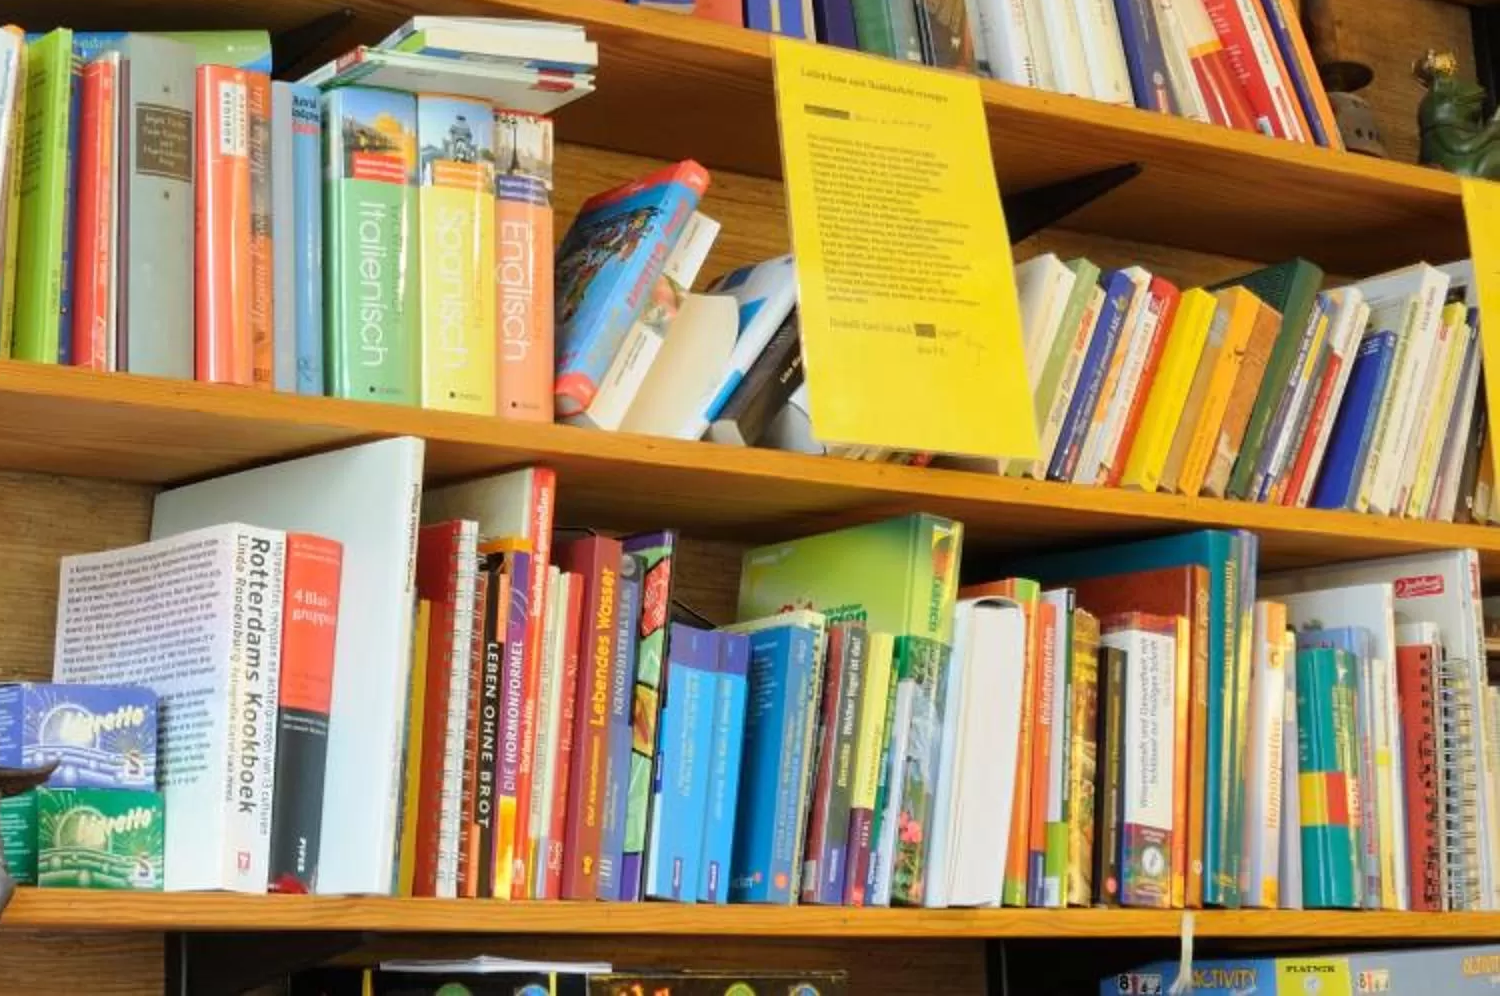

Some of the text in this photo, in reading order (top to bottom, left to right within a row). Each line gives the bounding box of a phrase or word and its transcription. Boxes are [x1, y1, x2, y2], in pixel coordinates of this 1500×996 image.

[359, 201, 386, 366] Italienisch
[435, 206, 467, 370] Spanisch
[494, 219, 530, 362] Englisch
[231, 534, 247, 660] Linda Roodenburg
[239, 537, 271, 813] Rotterdams Kookboek
[293, 591, 303, 603] 4
[588, 565, 616, 727] Lebendes Wasser
[477, 641, 498, 827] LEBEN OHNE BROT
[502, 766, 516, 791] DIE
